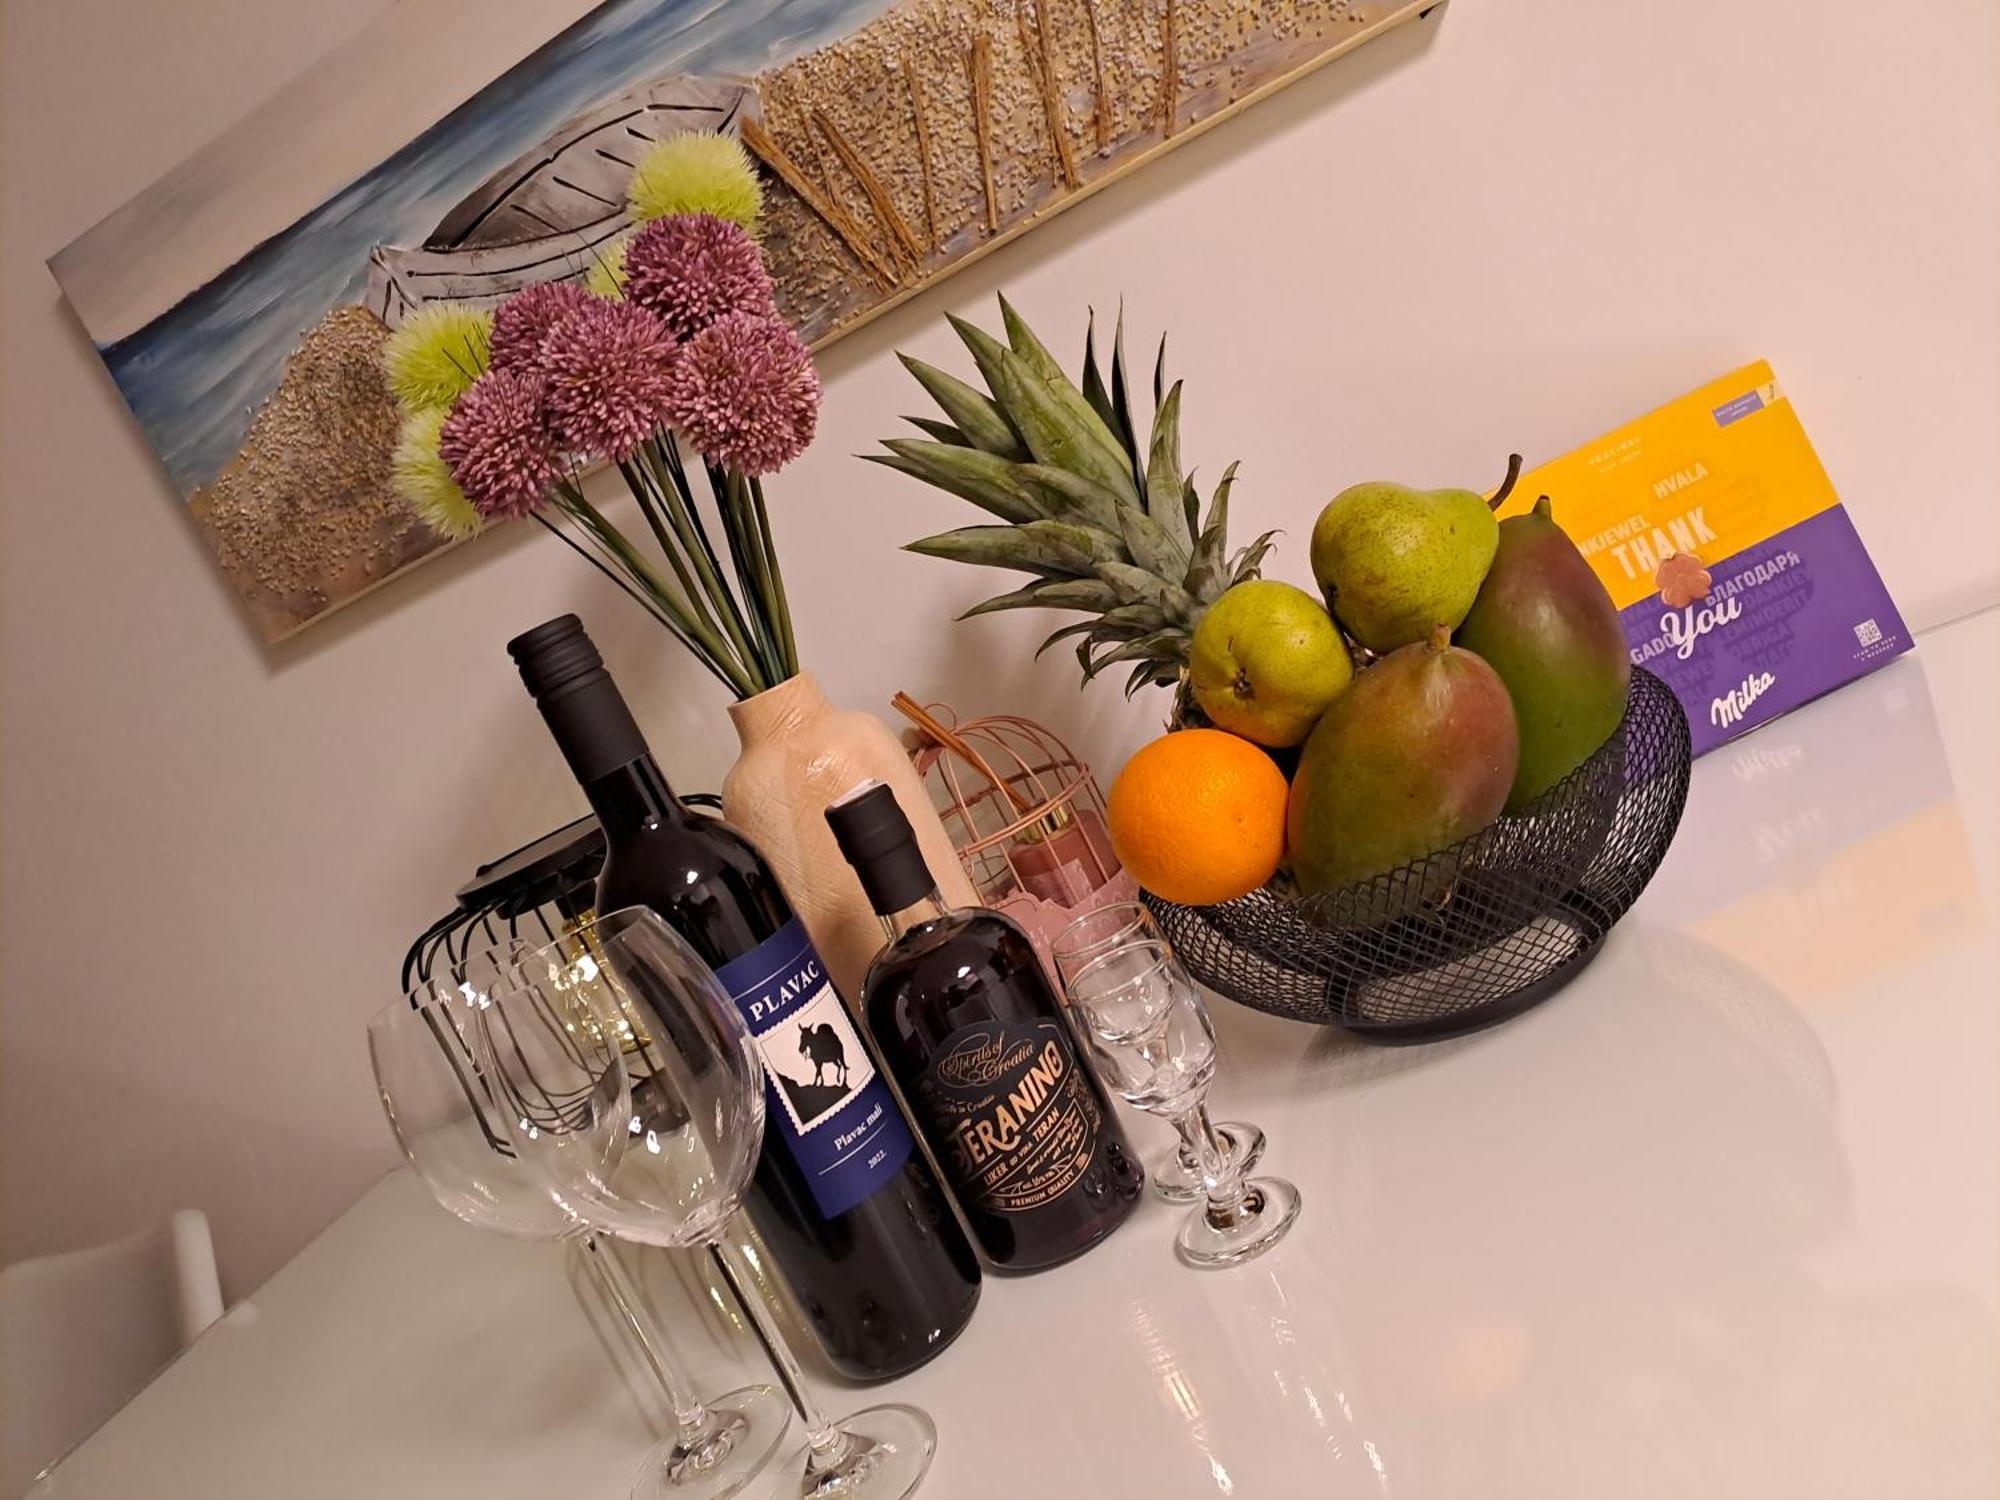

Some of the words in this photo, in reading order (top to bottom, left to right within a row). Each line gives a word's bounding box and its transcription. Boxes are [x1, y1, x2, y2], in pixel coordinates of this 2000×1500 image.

[1653, 461, 1708, 499] HVALA
[1577, 514, 1651, 556] NKJEWEL
[1611, 506, 1717, 580] THANK
[1630, 632, 1675, 664] GADO
[1660, 597, 1742, 660] You
[1711, 671, 1775, 728] Milka
[750, 960, 820, 1022] PLAVAC
[974, 1039, 1034, 1082] Croatia
[834, 1121, 867, 1151] Plavac
[867, 1102, 883, 1129] mali
[983, 1162, 1009, 1186] LIKER
[1033, 1106, 1060, 1141] TERAN
[1011, 1192, 1046, 1207] PREMIUM
[1047, 1169, 1075, 1196] QUALITY
